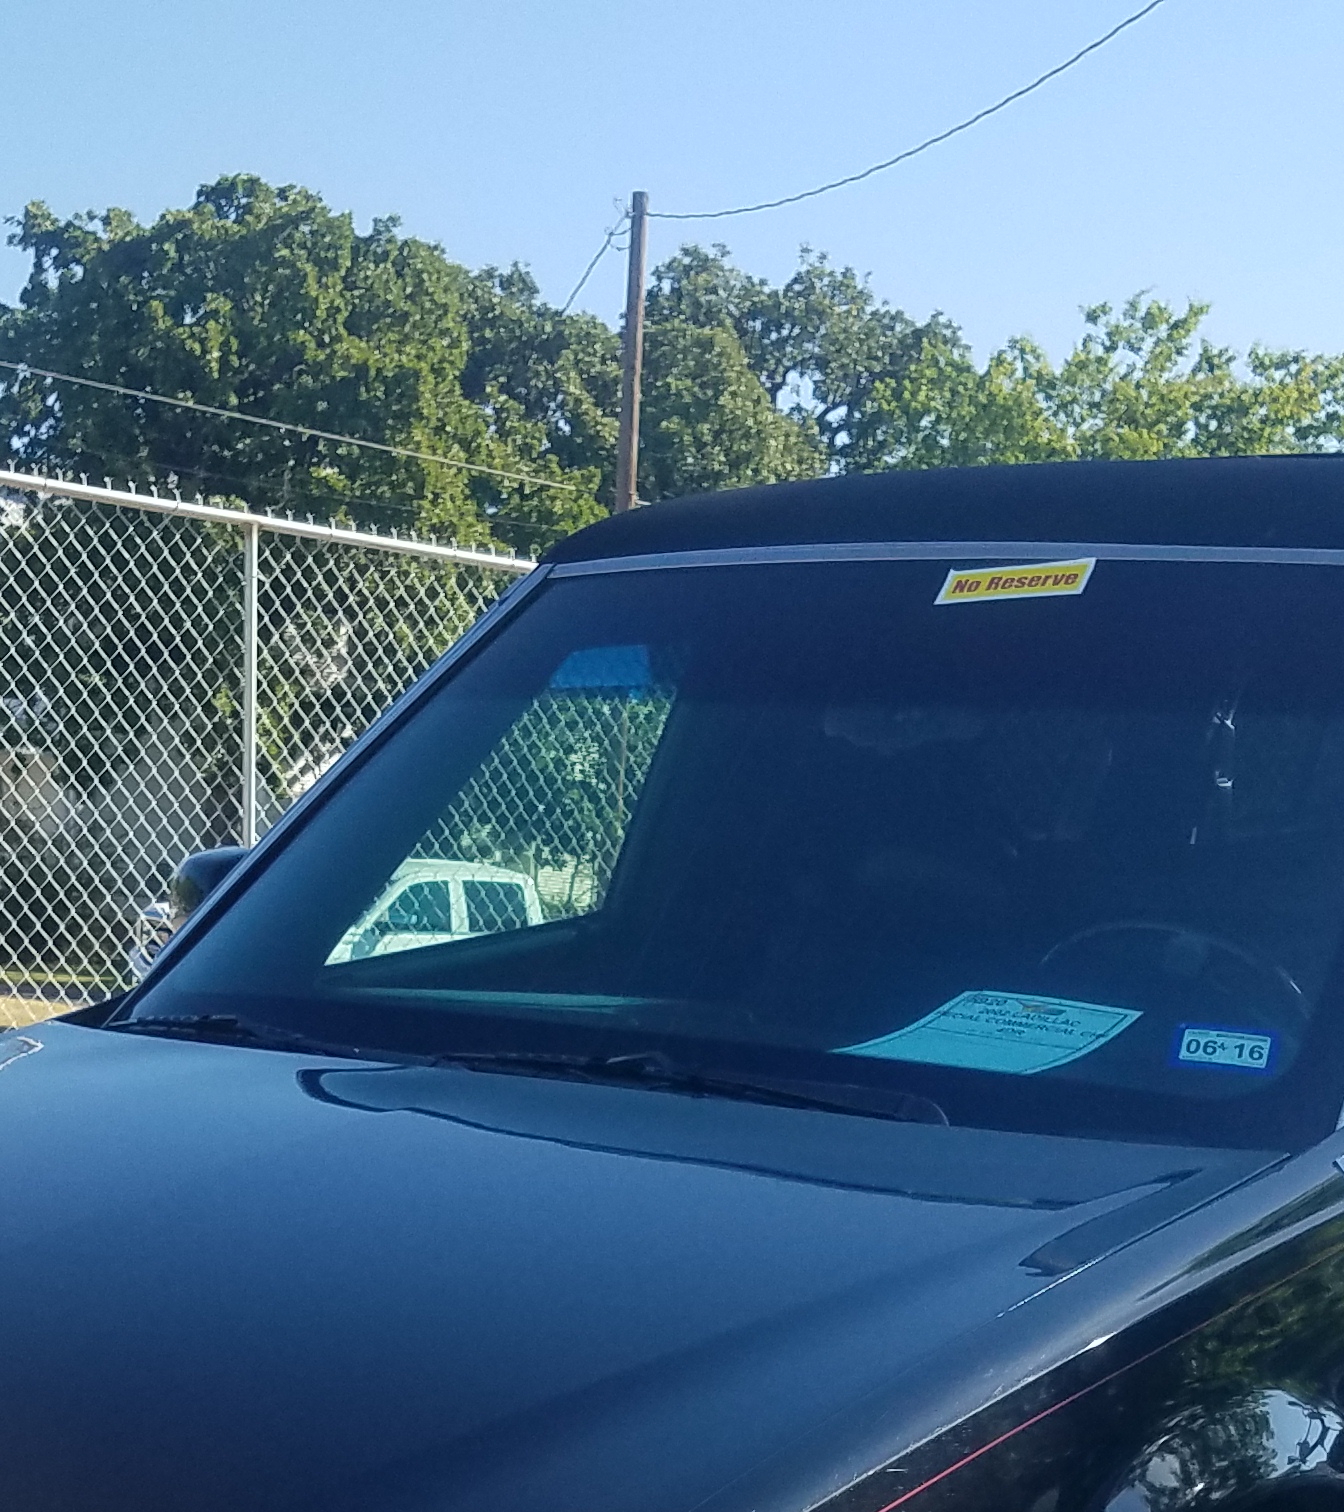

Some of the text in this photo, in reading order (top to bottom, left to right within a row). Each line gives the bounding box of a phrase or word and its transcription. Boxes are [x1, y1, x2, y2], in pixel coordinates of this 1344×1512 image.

[952, 572, 1079, 594] No Reserve
[1185, 1038, 1265, 1061] 06 16
